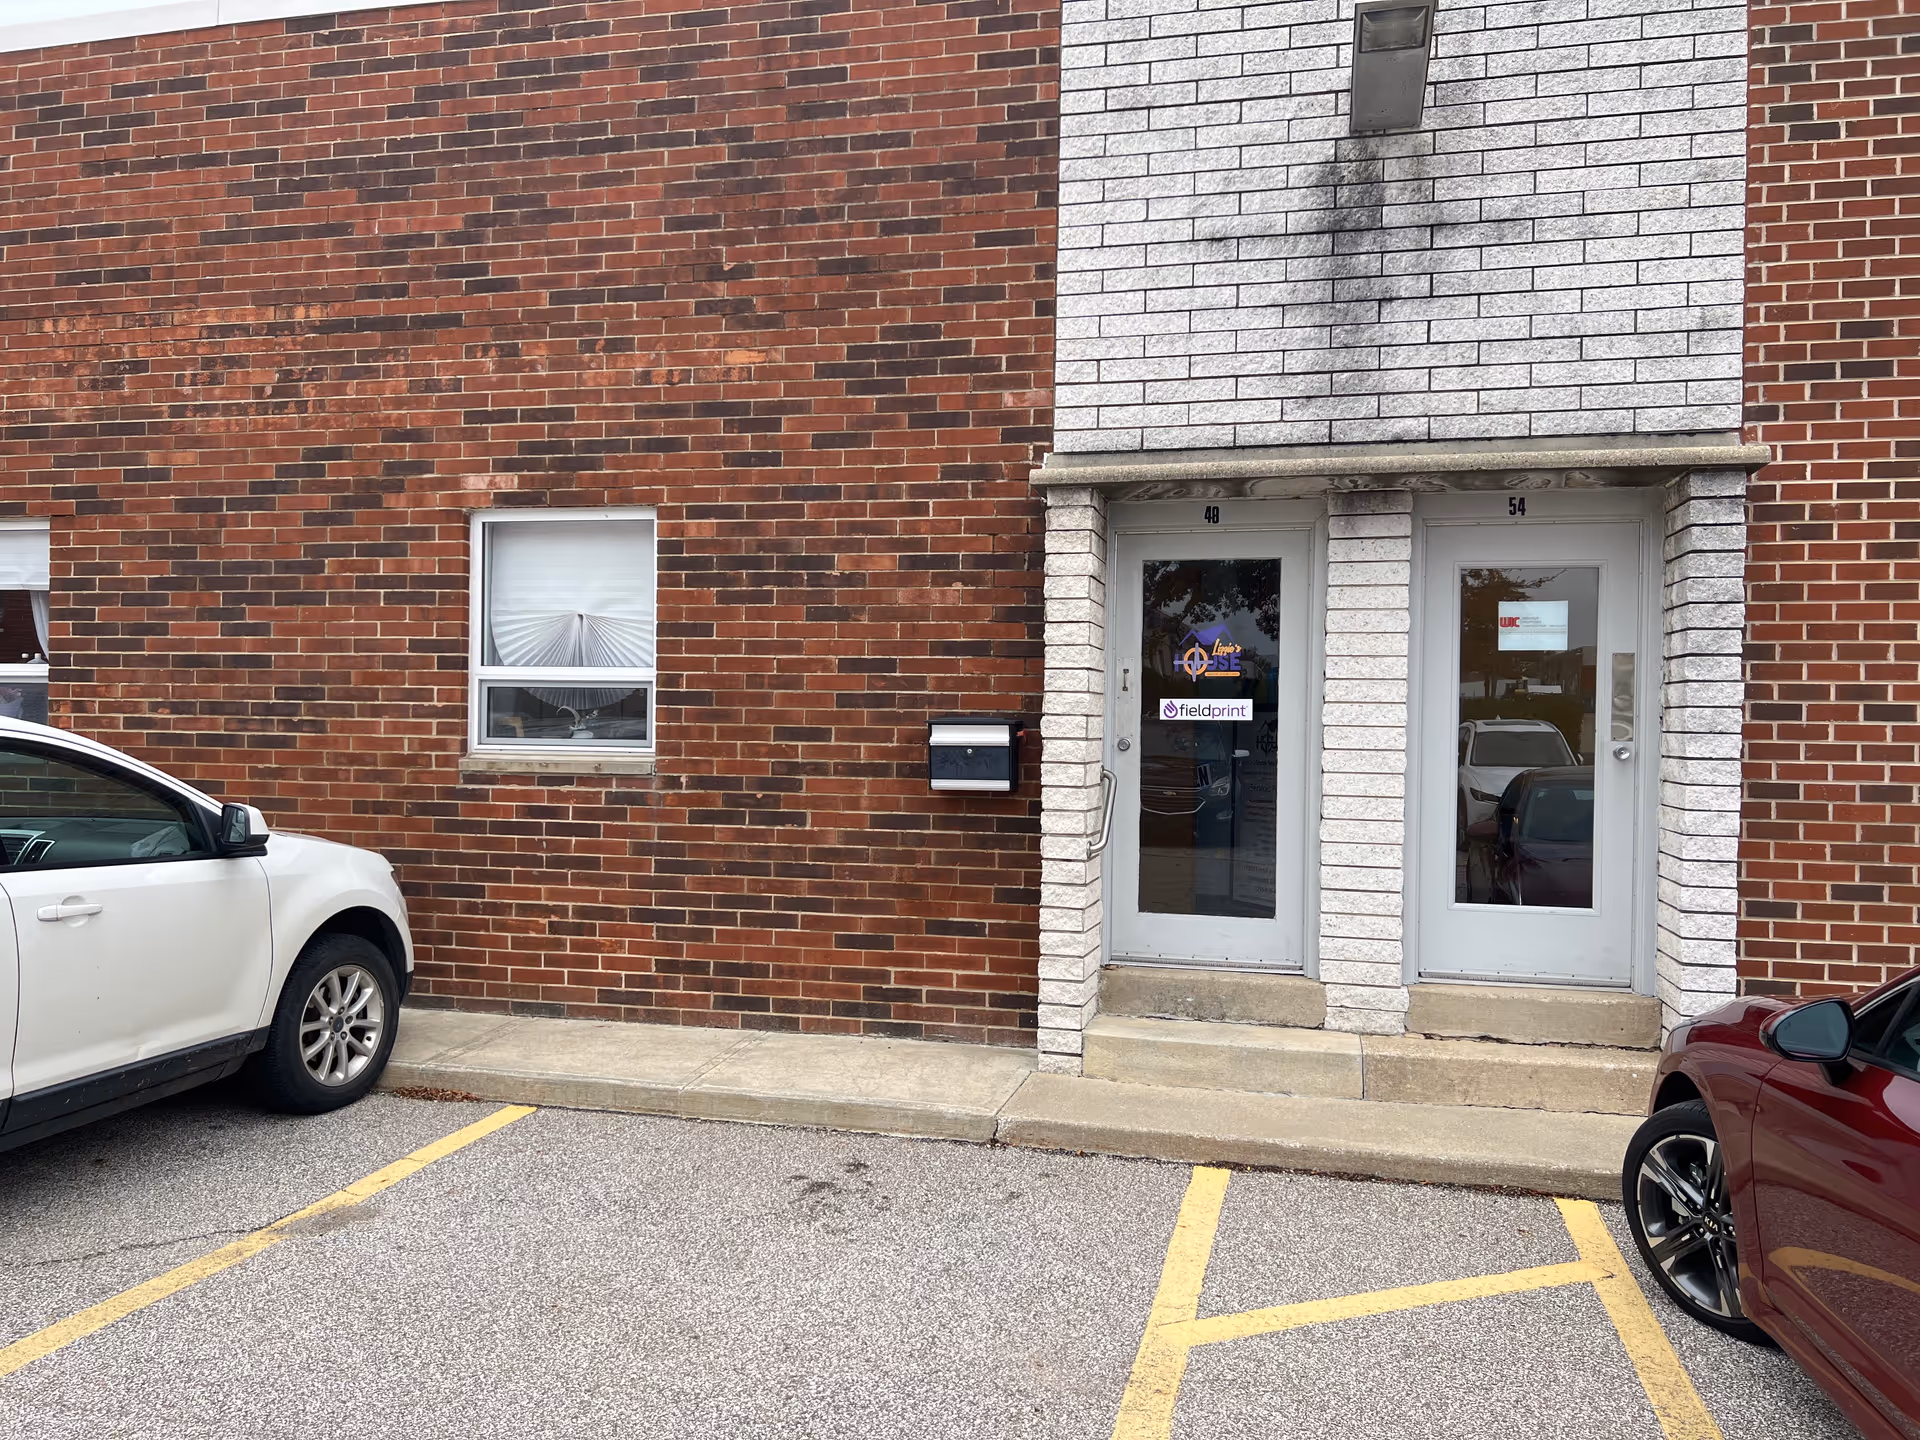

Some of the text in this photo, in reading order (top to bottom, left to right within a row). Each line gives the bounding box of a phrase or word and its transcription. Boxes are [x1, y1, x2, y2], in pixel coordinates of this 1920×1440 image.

[1204, 505, 1220, 524] 48
[1508, 496, 1526, 516] 54
[1173, 647, 1242, 676] HOUSE
[1179, 703, 1246, 719] fieldprint
[1704, 1215, 1718, 1232] KIA
